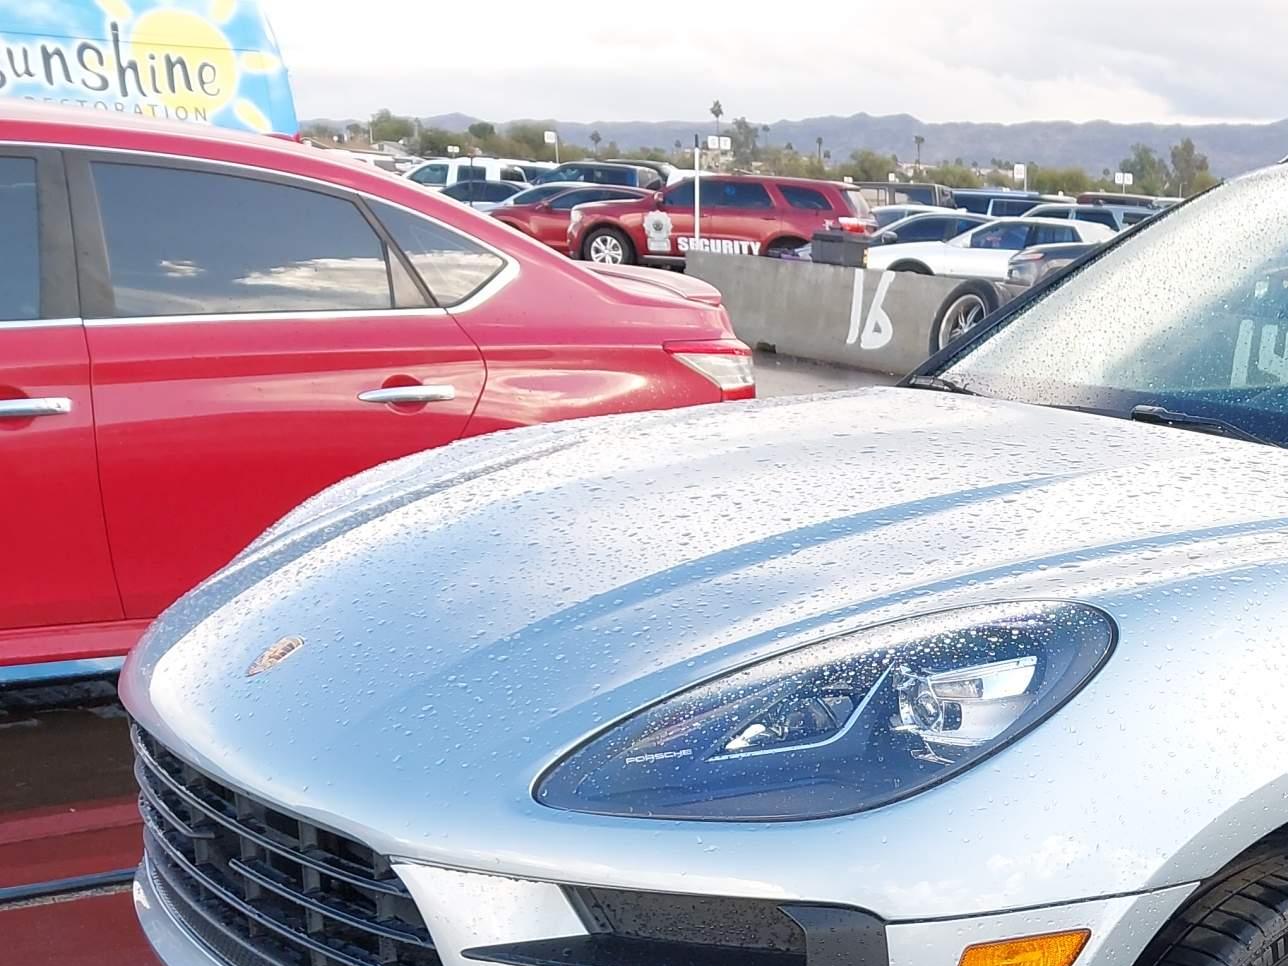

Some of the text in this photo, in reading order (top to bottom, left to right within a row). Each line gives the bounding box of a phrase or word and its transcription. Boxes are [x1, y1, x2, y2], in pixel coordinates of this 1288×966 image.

[0, 21, 220, 97] unshine
[677, 237, 761, 256] SECURITY
[846, 268, 896, 350] 16
[625, 749, 692, 765] PORSCHE
